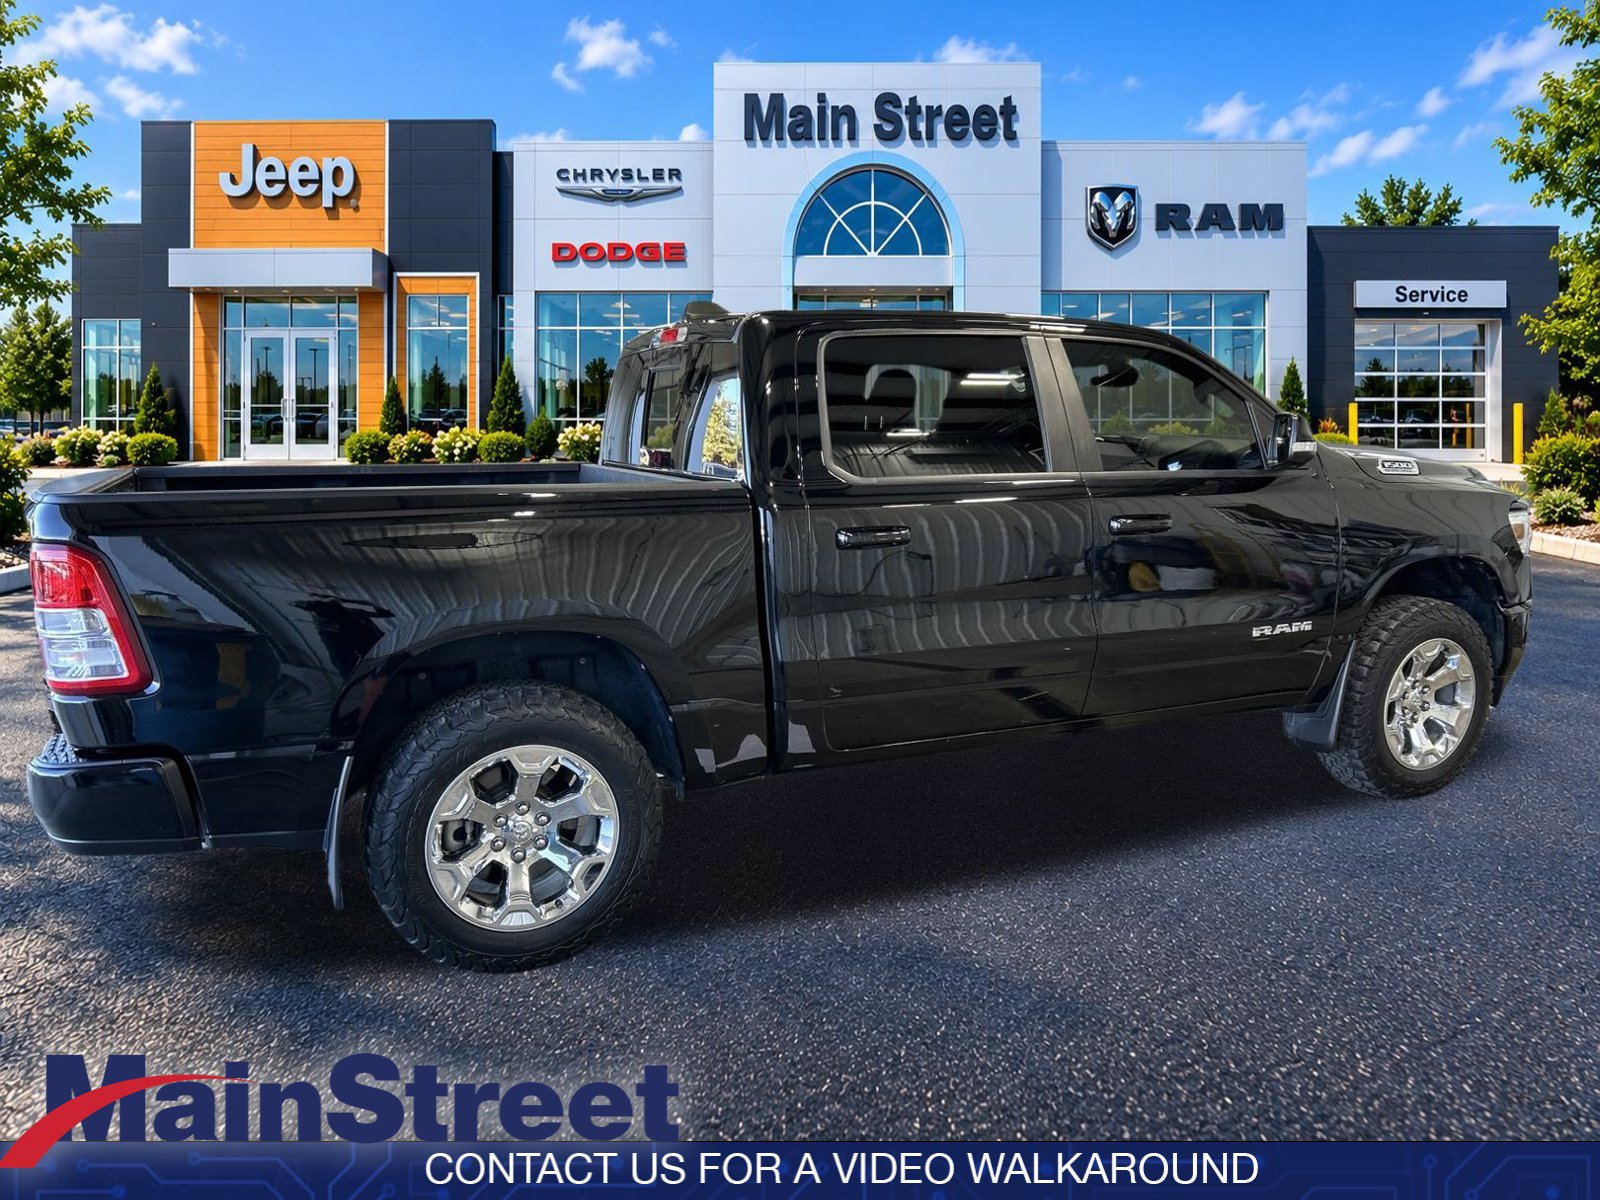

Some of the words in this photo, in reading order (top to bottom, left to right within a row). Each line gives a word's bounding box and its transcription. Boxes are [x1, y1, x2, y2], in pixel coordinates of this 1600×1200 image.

[744, 93, 856, 141] Main
[873, 92, 1017, 141] Street
[218, 143, 355, 208] Jeep
[556, 168, 683, 182] CHRYSLER
[1155, 203, 1284, 231] RAM
[551, 242, 686, 261] DODGE
[1395, 285, 1469, 303] Service
[1252, 620, 1313, 637] RAM
